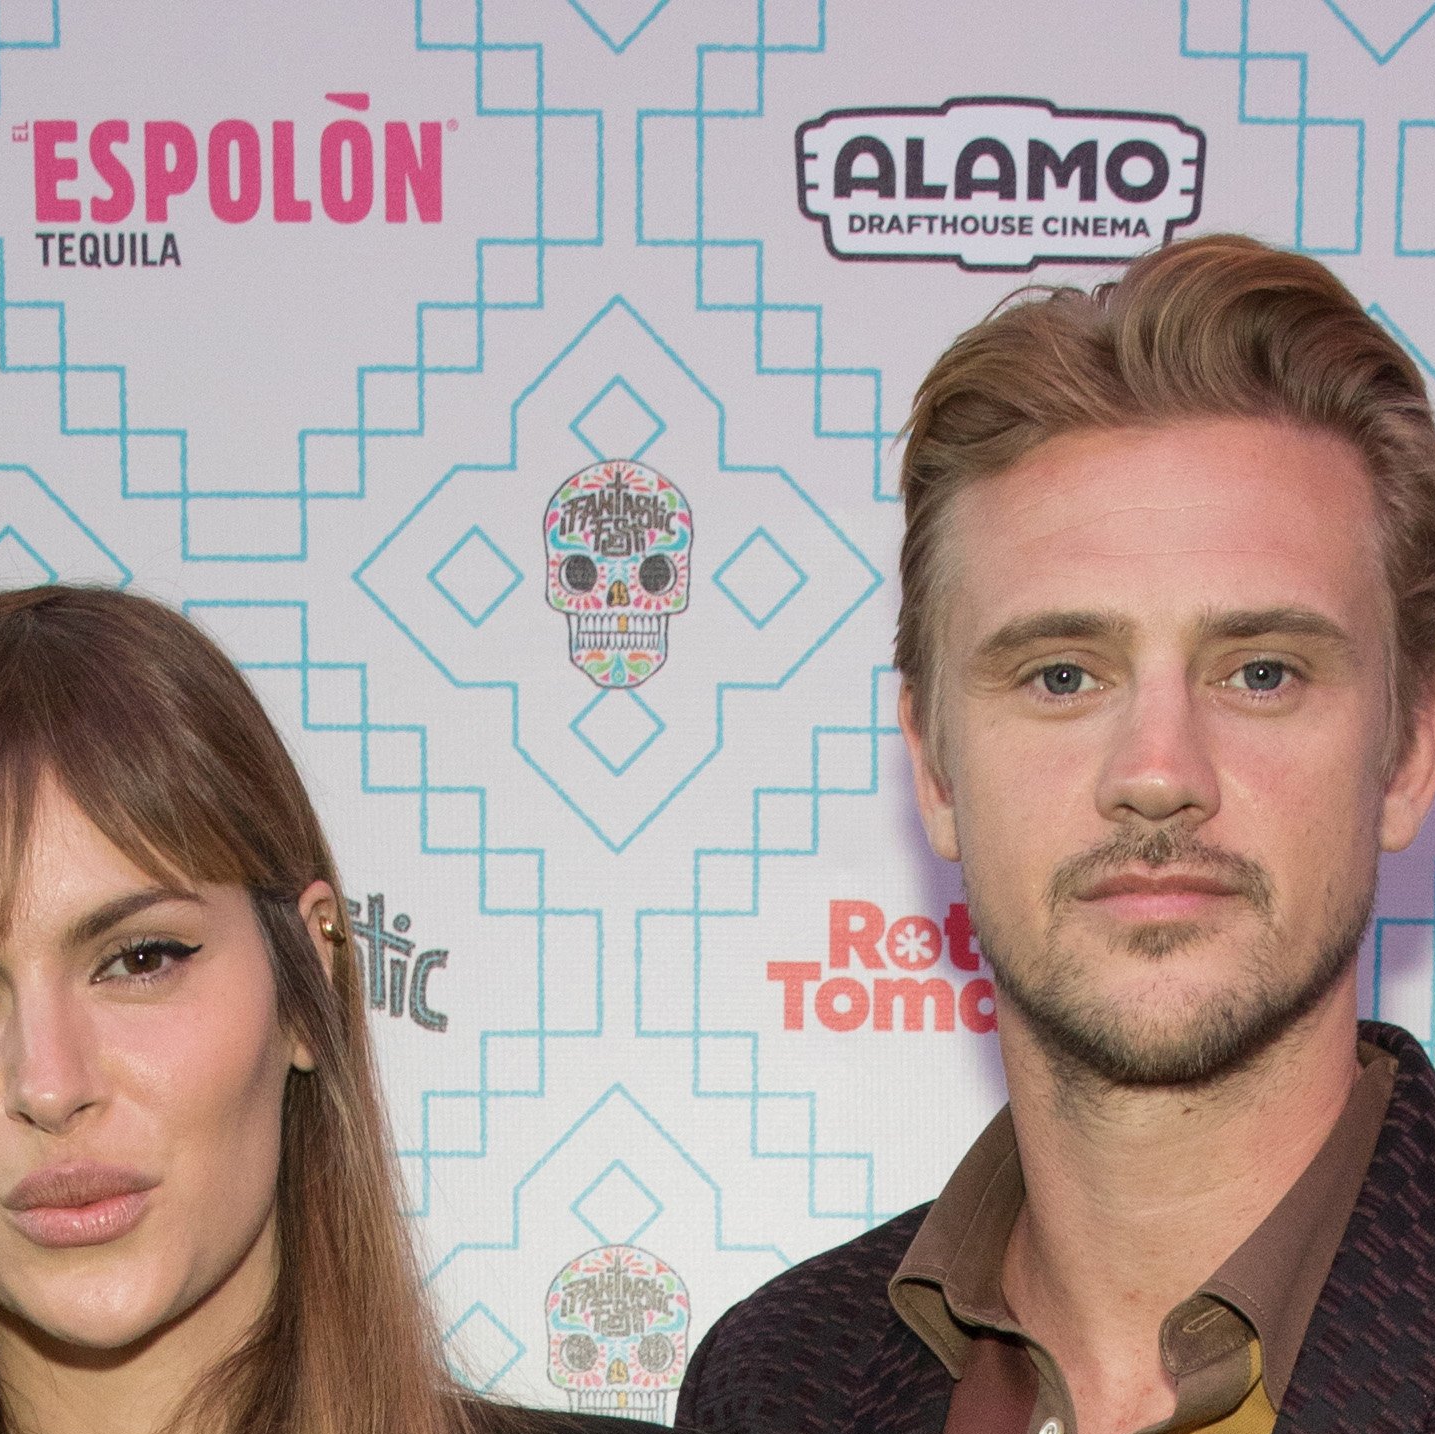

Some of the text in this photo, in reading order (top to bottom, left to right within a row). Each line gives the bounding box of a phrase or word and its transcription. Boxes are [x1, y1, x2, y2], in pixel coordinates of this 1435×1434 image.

[834, 136, 1170, 203] ALAMO
[36, 233, 181, 268] TEQUILA
[848, 215, 1151, 238] DRAFTHOUSE CINEMA
[829, 899, 979, 971] Rot
[767, 961, 999, 1034] Toma
